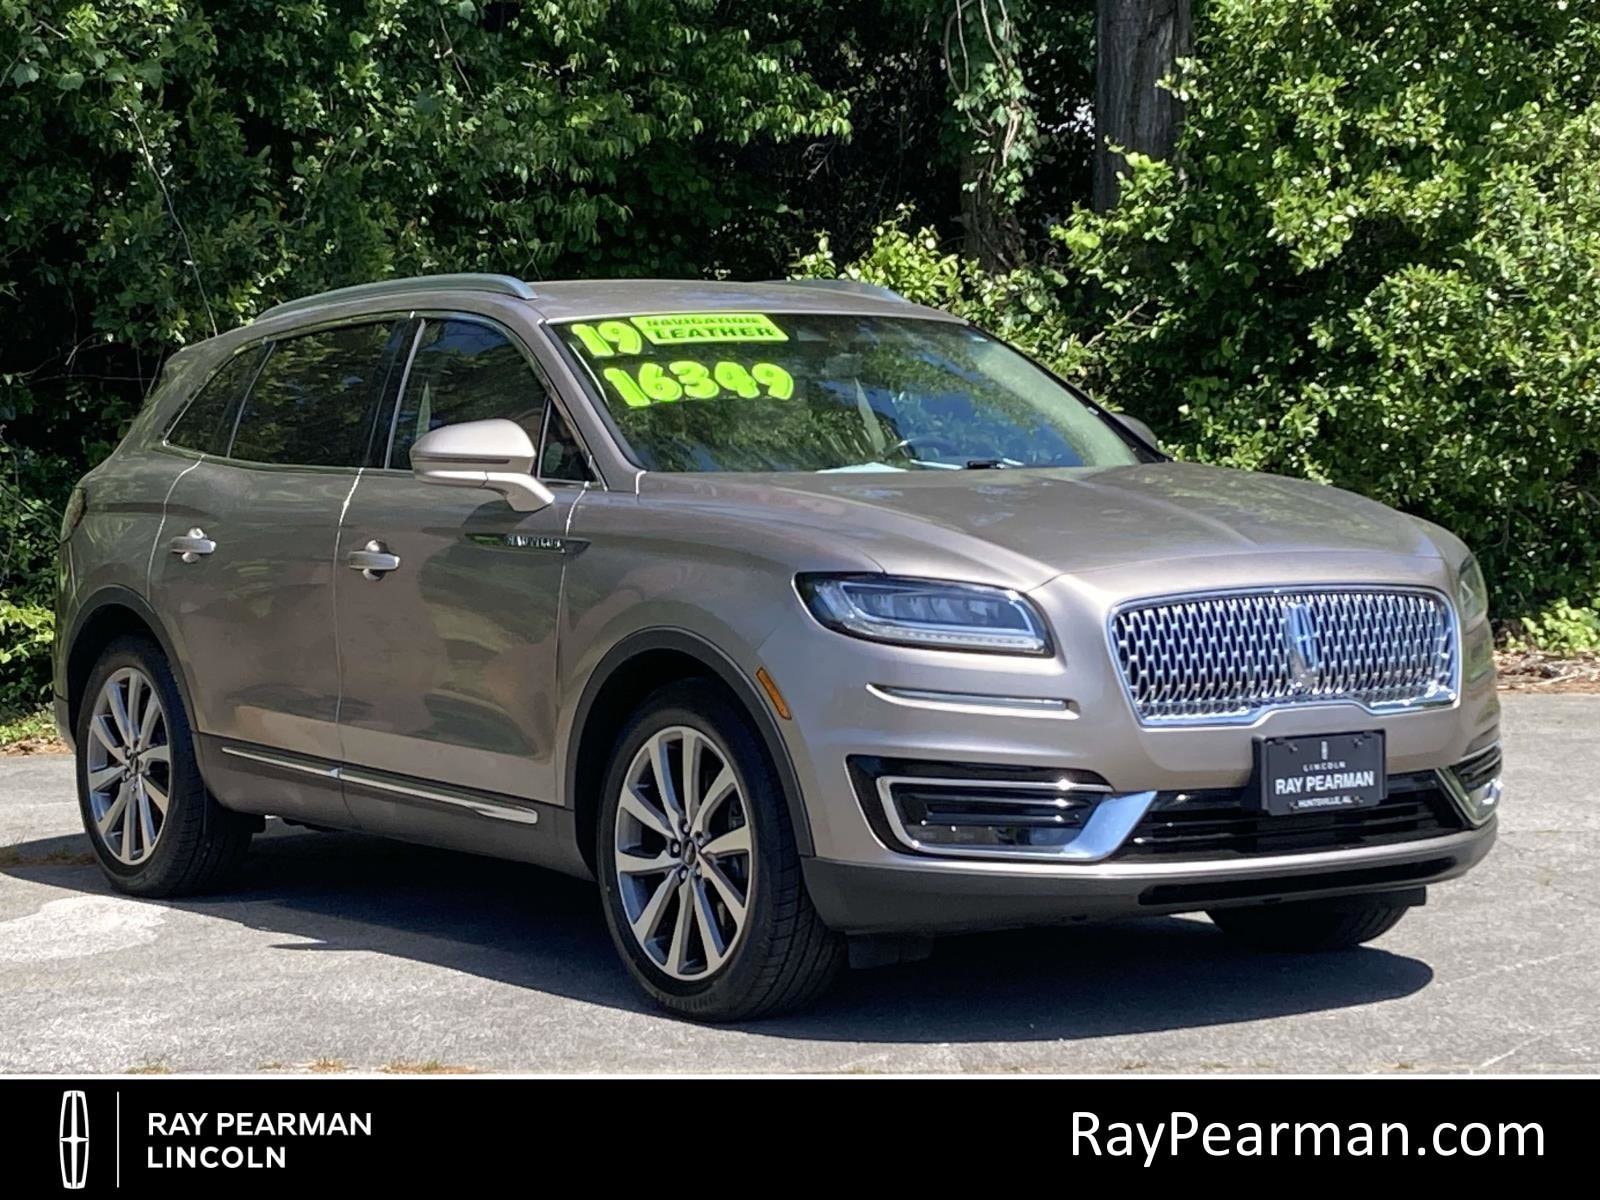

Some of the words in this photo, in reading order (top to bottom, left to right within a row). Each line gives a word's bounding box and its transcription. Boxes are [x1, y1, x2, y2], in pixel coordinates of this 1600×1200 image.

[571, 321, 642, 356] 19
[653, 327, 775, 339] LEATHER
[603, 360, 794, 407] 16349
[1302, 761, 1347, 772] LINCOLN
[1275, 777, 1304, 795] RAY
[1306, 771, 1375, 792] PEARMAN
